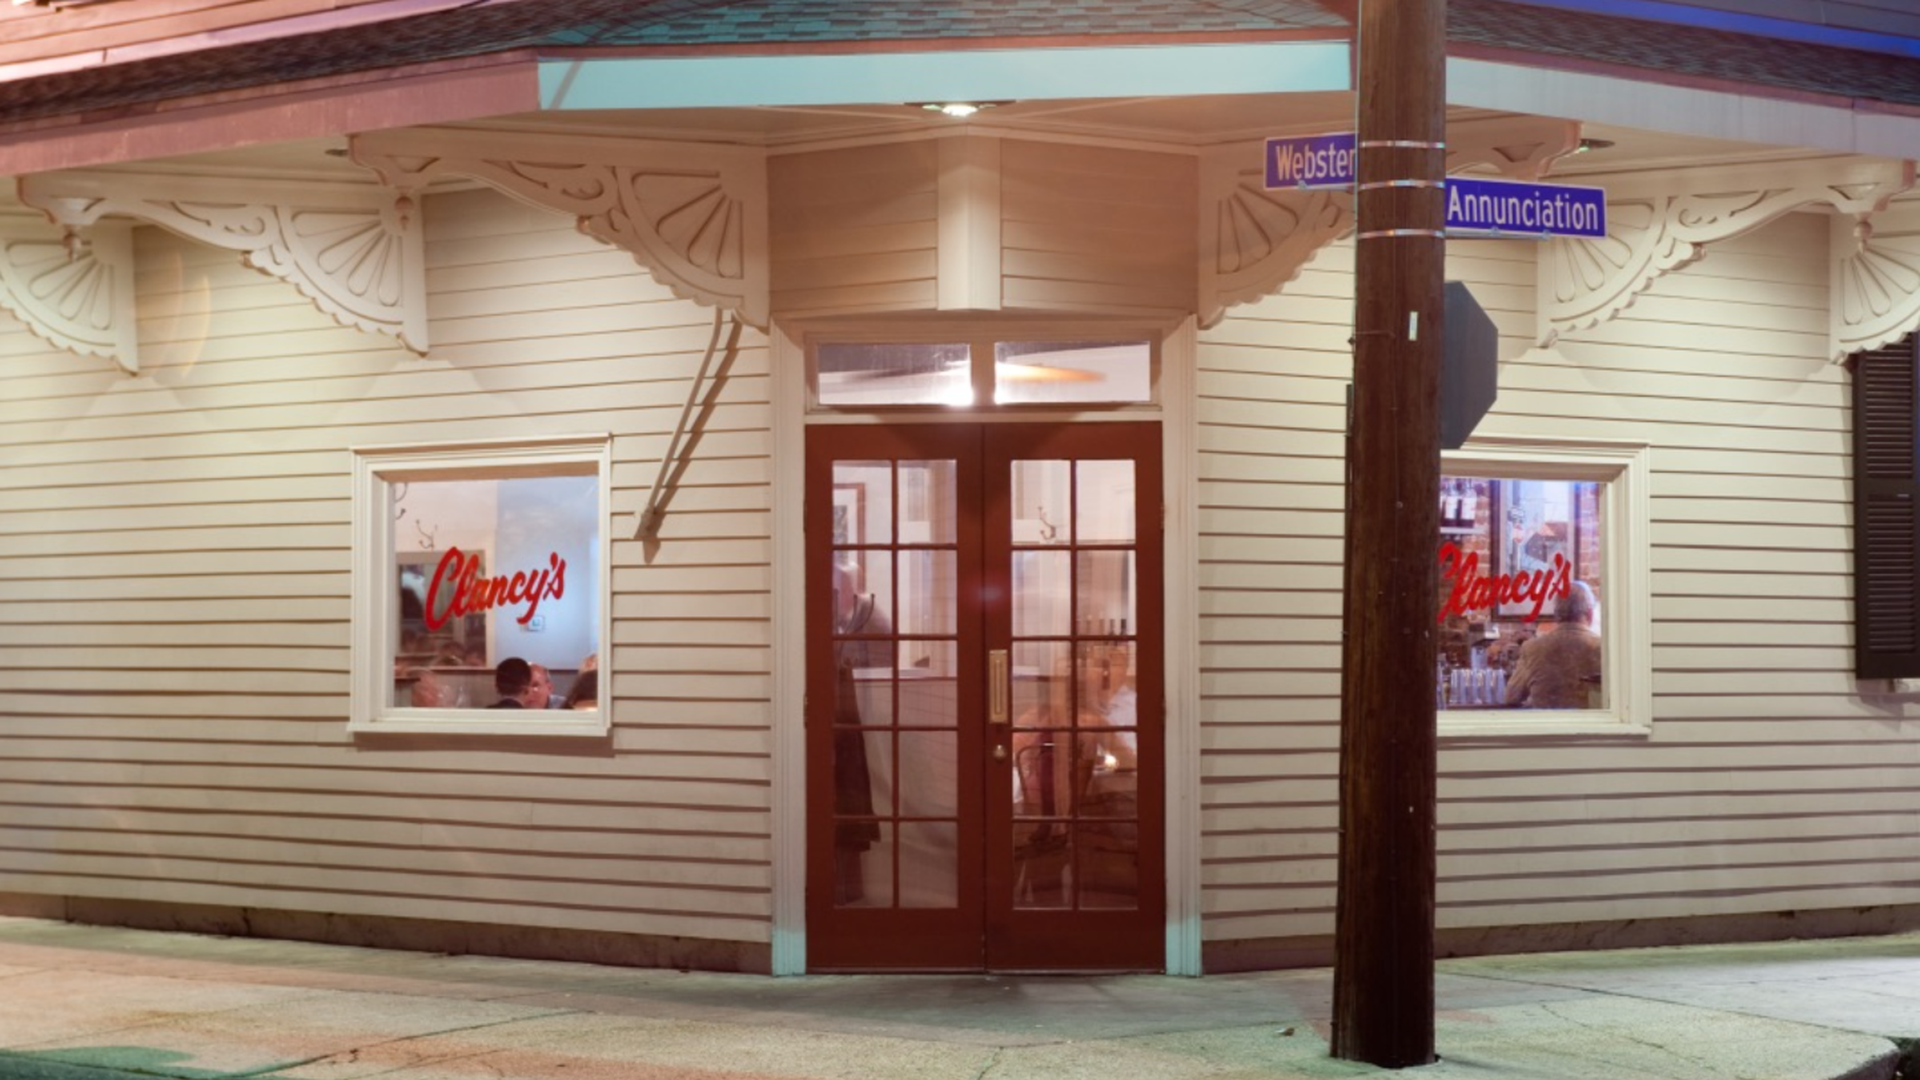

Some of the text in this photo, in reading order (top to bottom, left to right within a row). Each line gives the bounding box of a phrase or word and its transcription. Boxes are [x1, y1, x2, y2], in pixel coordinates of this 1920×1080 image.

[1276, 142, 1355, 181] Webster
[1447, 184, 1598, 230] Annunciation
[424, 546, 566, 631] Clancy's
